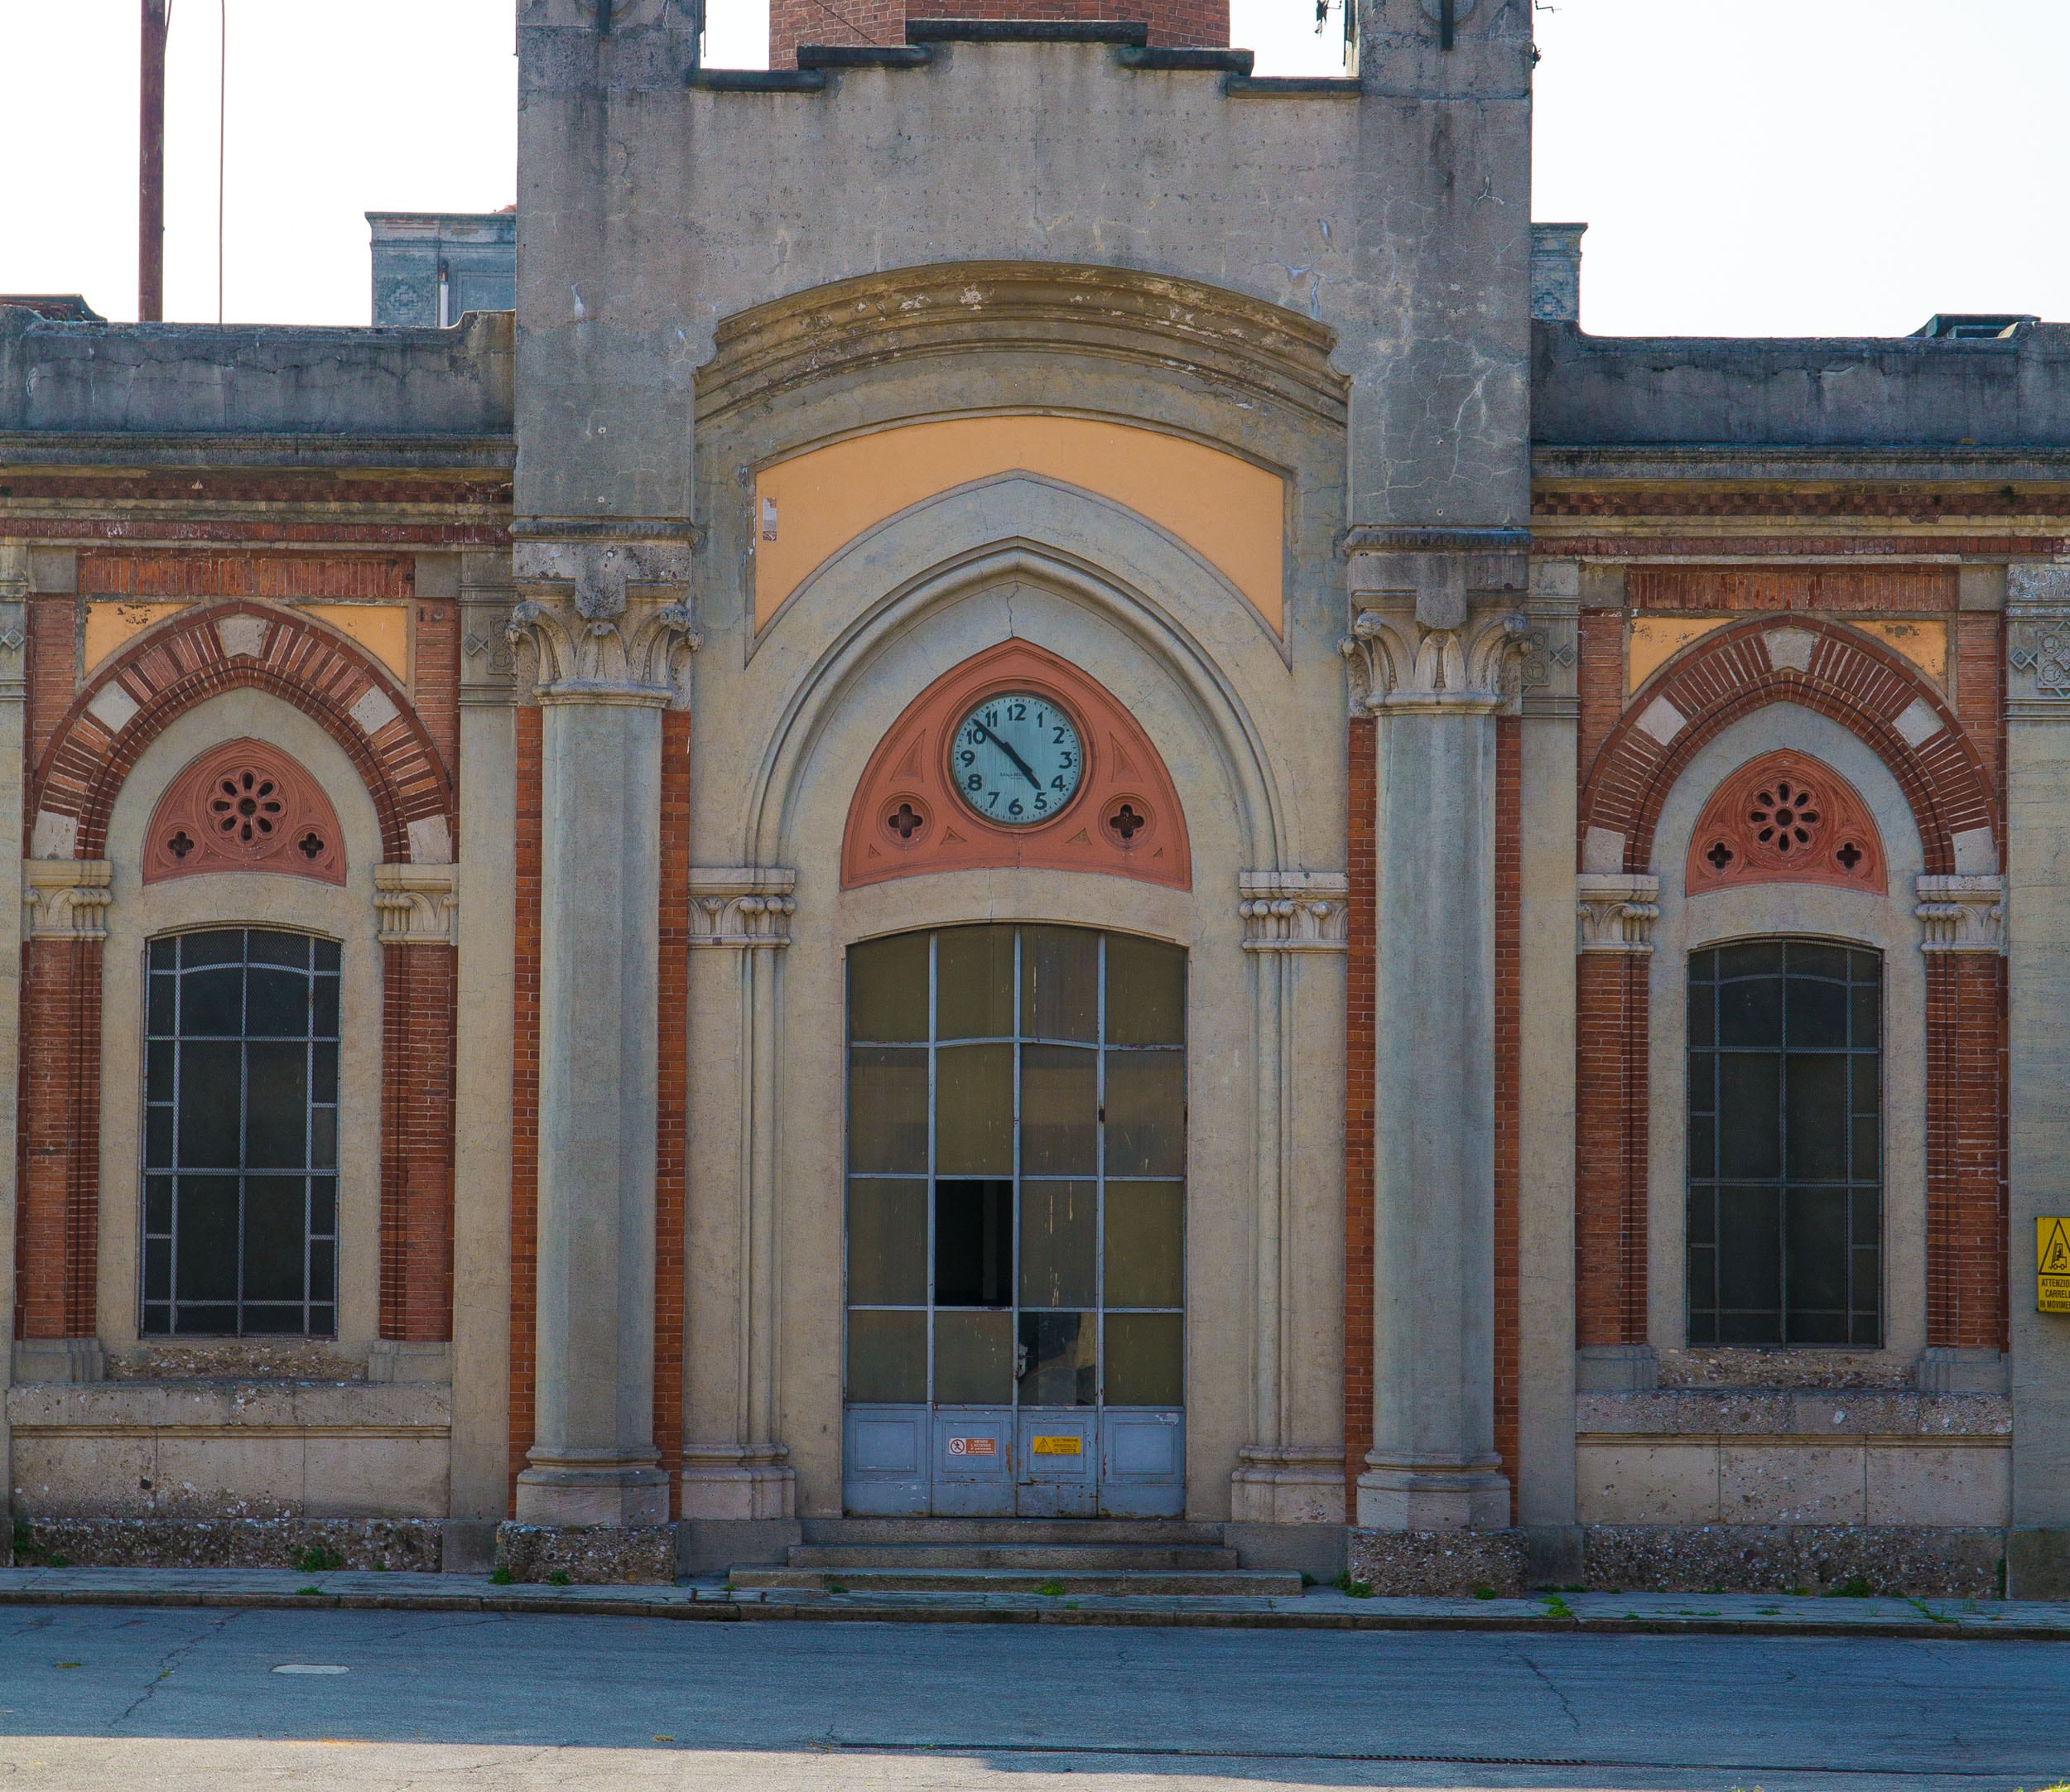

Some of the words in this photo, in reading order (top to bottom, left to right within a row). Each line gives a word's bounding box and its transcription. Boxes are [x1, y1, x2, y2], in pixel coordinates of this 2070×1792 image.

[985, 711, 998, 727] 11
[1007, 704, 1026, 721] 12
[1037, 711, 1042, 728] 1
[966, 728, 986, 744] 10
[1052, 726, 1065, 744] 2
[960, 750, 975, 768] 9
[1059, 751, 1072, 768] 3
[967, 773, 982, 791] 8
[1051, 775, 1066, 792] 4
[988, 792, 1000, 808] 7
[1009, 798, 1023, 816] 6
[1033, 792, 1047, 810] 5
